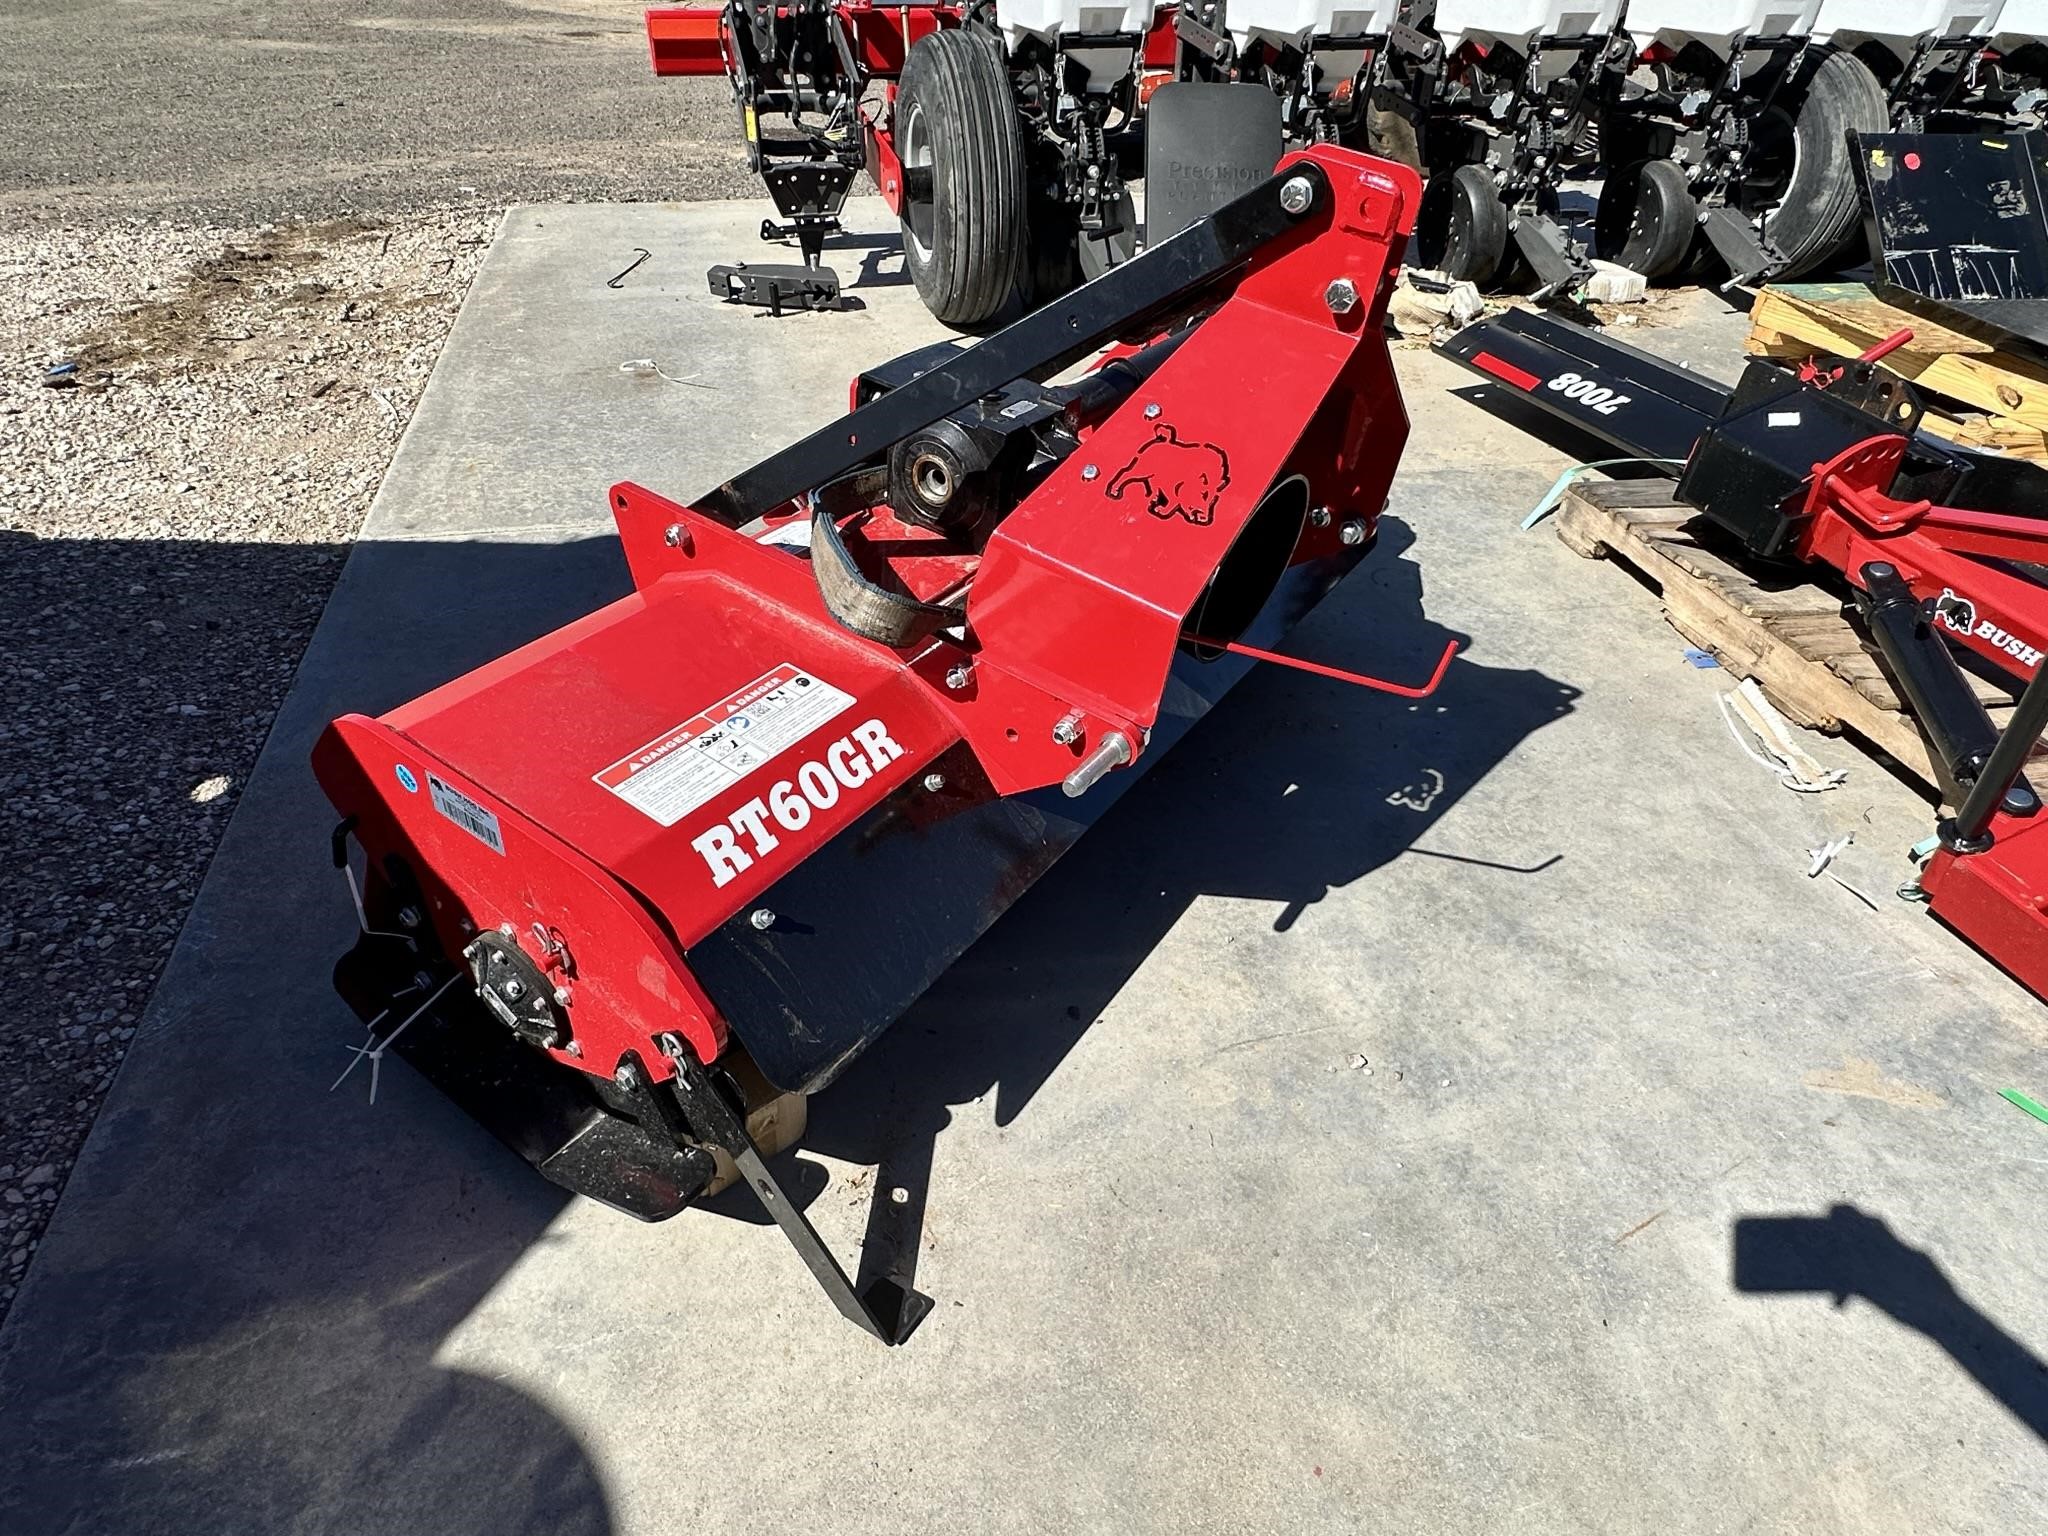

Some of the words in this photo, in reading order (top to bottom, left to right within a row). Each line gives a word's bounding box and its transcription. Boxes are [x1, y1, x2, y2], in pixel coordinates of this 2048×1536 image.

[1168, 161, 1265, 182] Precision
[1548, 373, 1632, 415] 7008
[1973, 620, 2046, 667] BUSH
[735, 678, 783, 706] DANGER
[641, 732, 694, 763] DANGER
[691, 718, 905, 889] RT60GR
